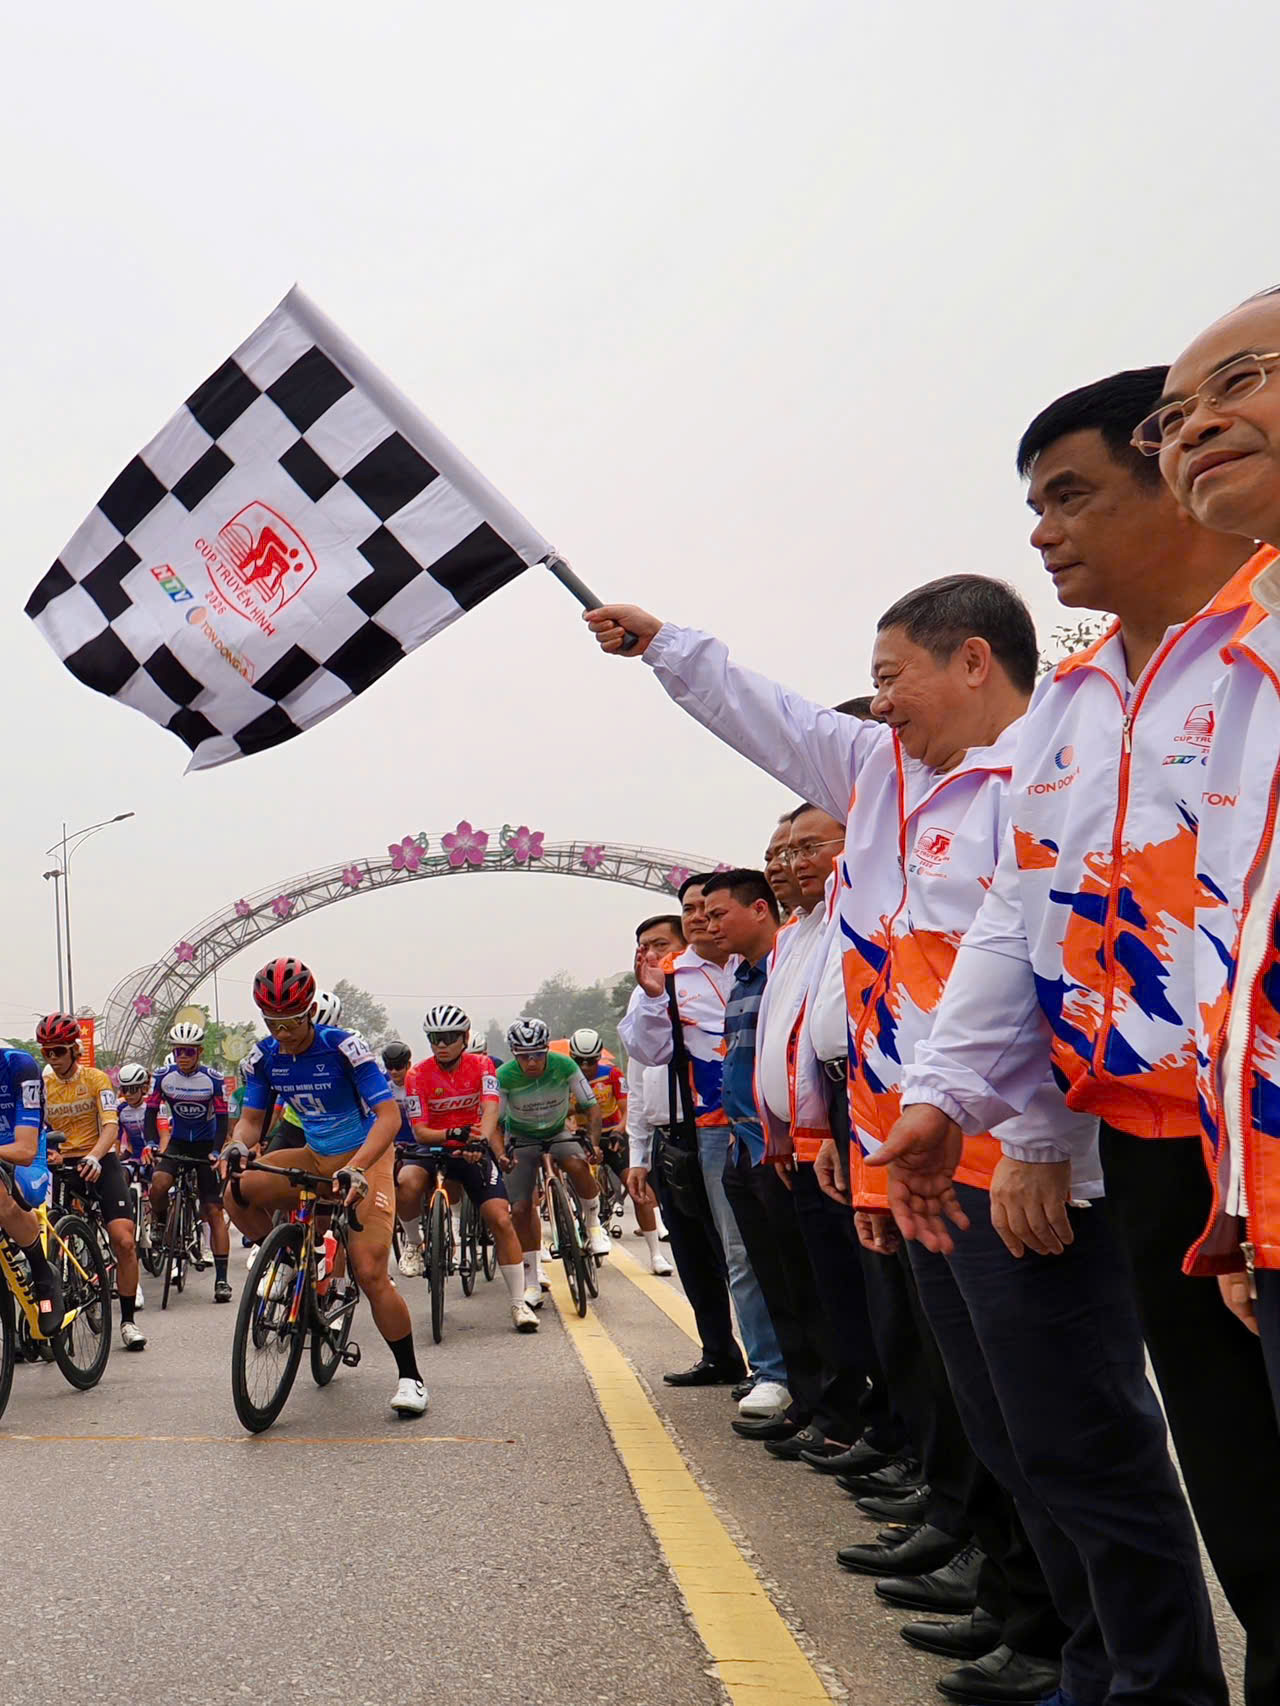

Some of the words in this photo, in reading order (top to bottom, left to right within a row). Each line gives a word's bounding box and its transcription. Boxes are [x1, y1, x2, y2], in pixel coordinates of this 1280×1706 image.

[150, 563, 194, 603] HTV
[194, 537, 217, 562] CÚP
[216, 559, 254, 610] TRUYỀN
[249, 604, 276, 637] HÌNH
[1162, 754, 1198, 766] HTV
[1026, 780, 1057, 796] TON
[348, 1042, 370, 1056] 74
[314, 1082, 332, 1090] CITY
